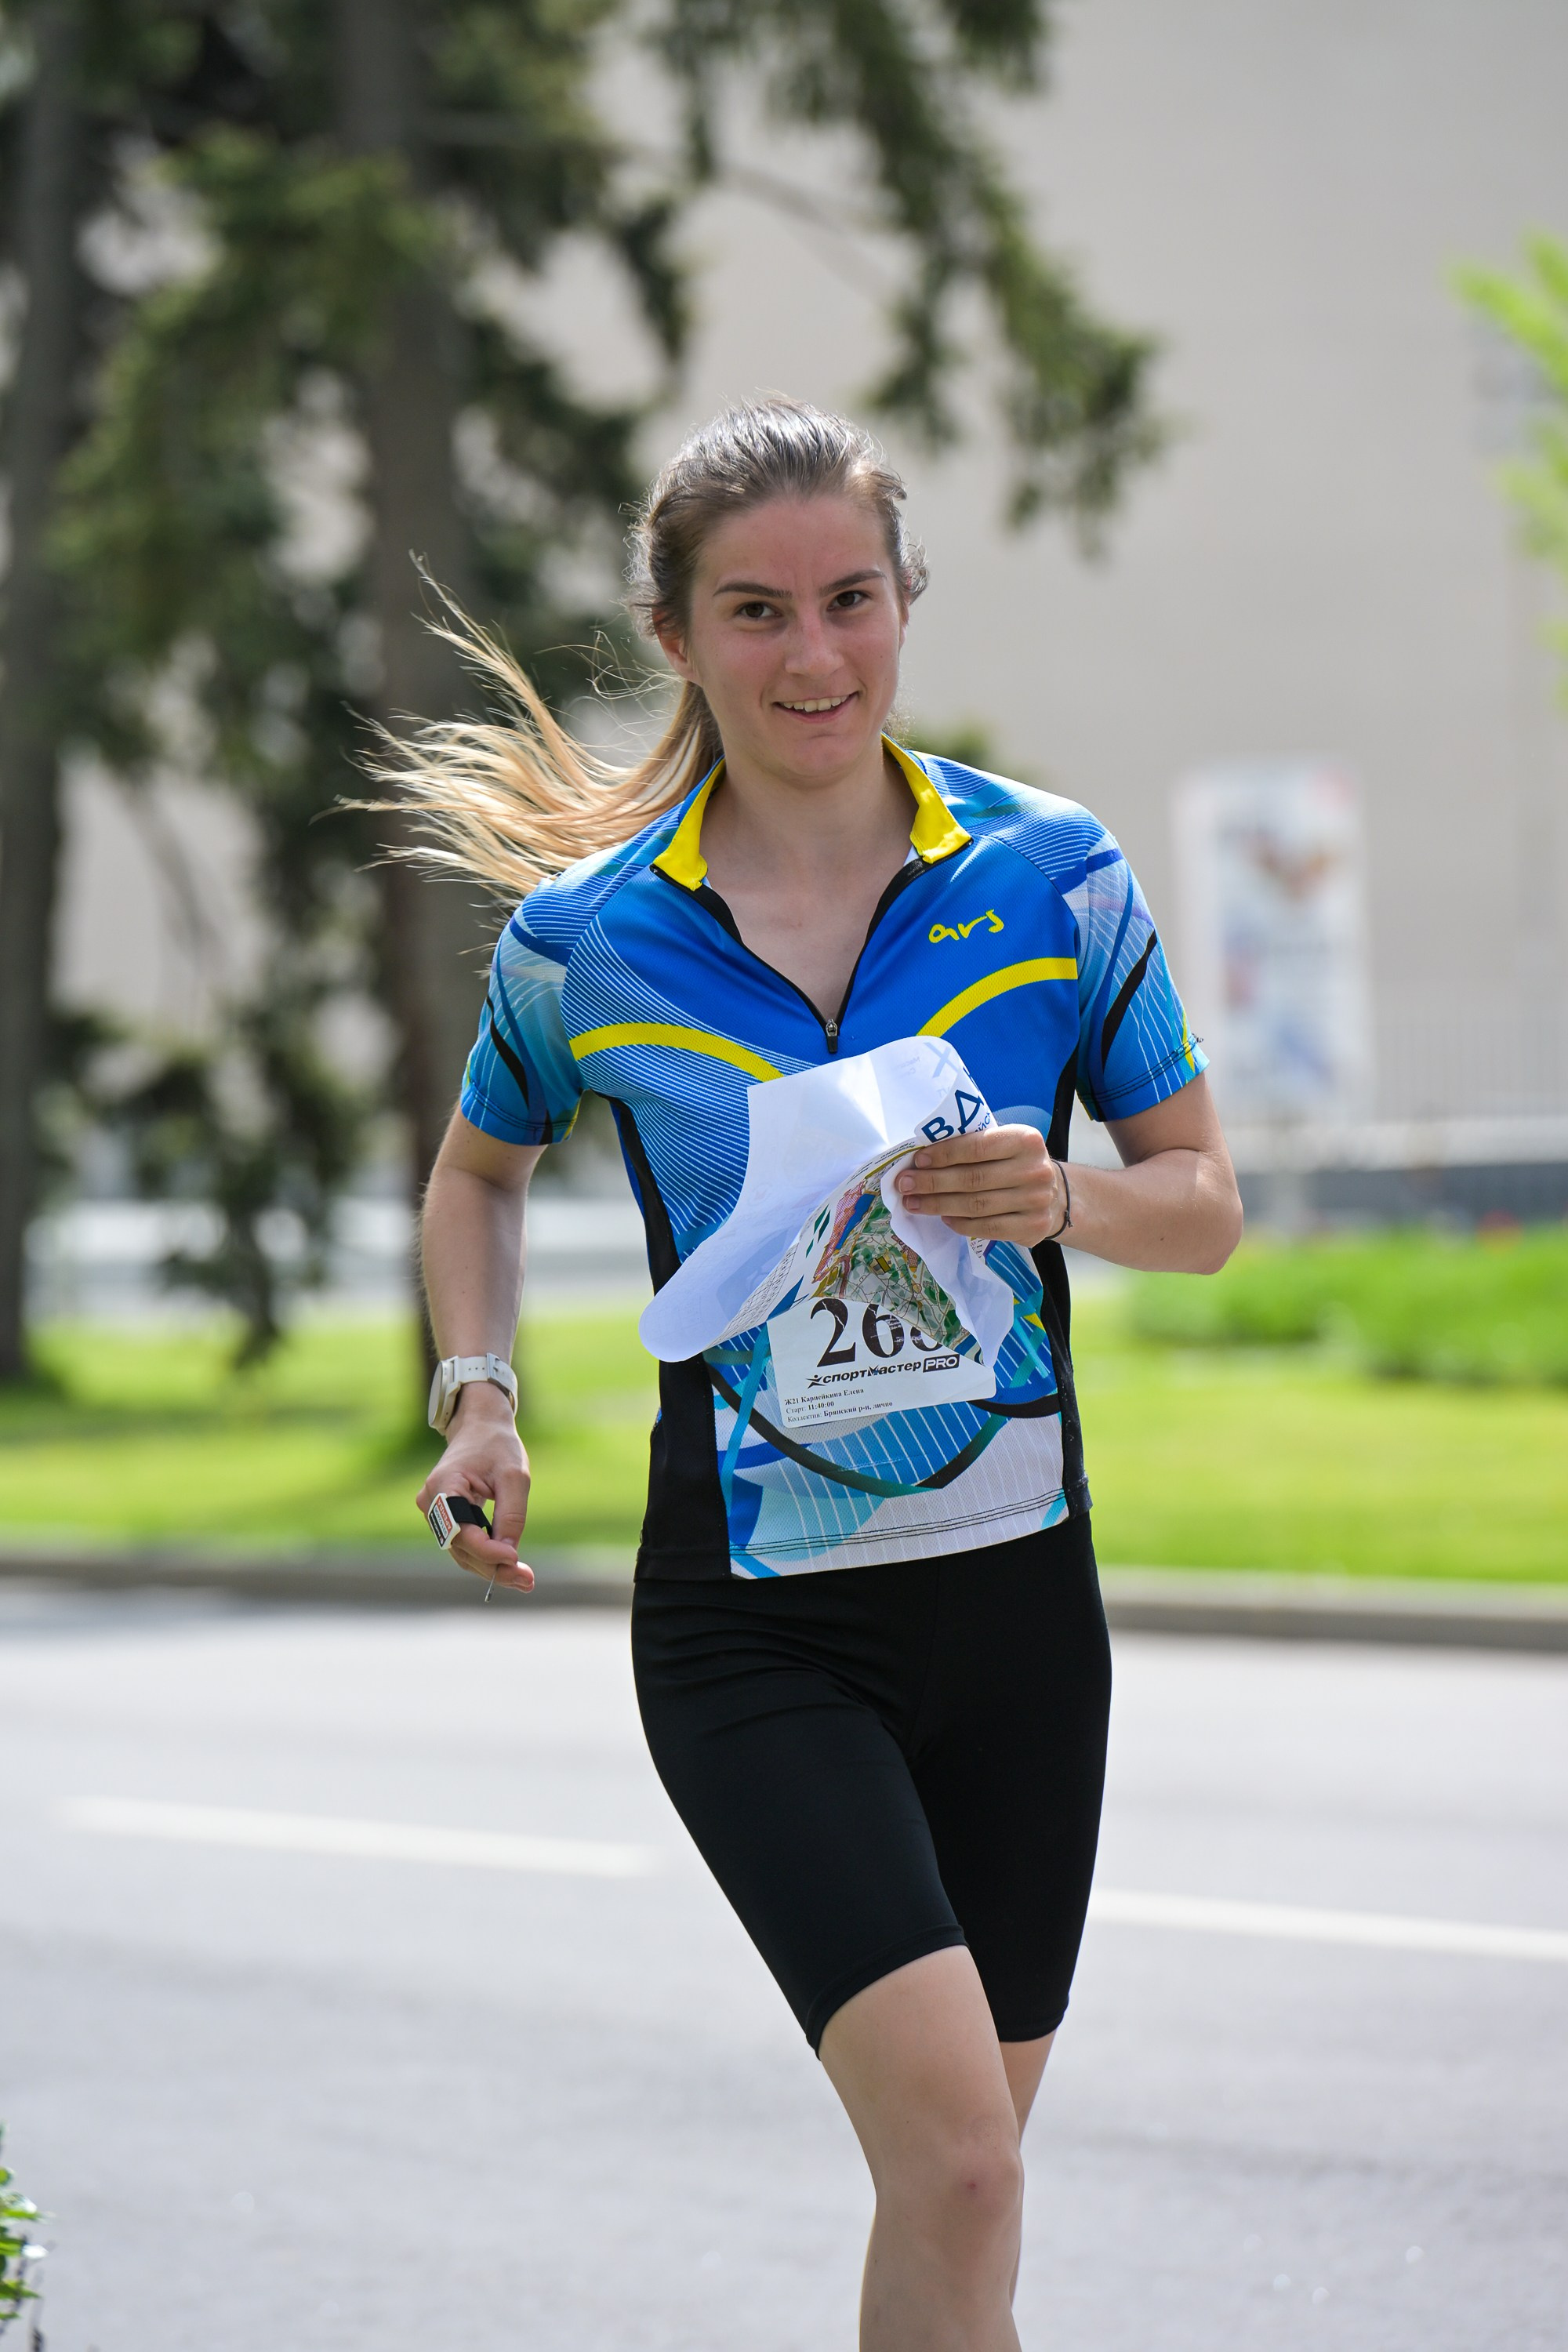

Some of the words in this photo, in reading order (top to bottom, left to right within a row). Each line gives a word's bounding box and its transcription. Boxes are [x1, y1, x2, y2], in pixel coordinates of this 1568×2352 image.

[925, 1357, 958, 1370] PRO
[784, 1397, 799, 1406] Ж21
[808, 1401, 834, 1410] 11:40:00
[824, 1406, 857, 1417] Брянский
